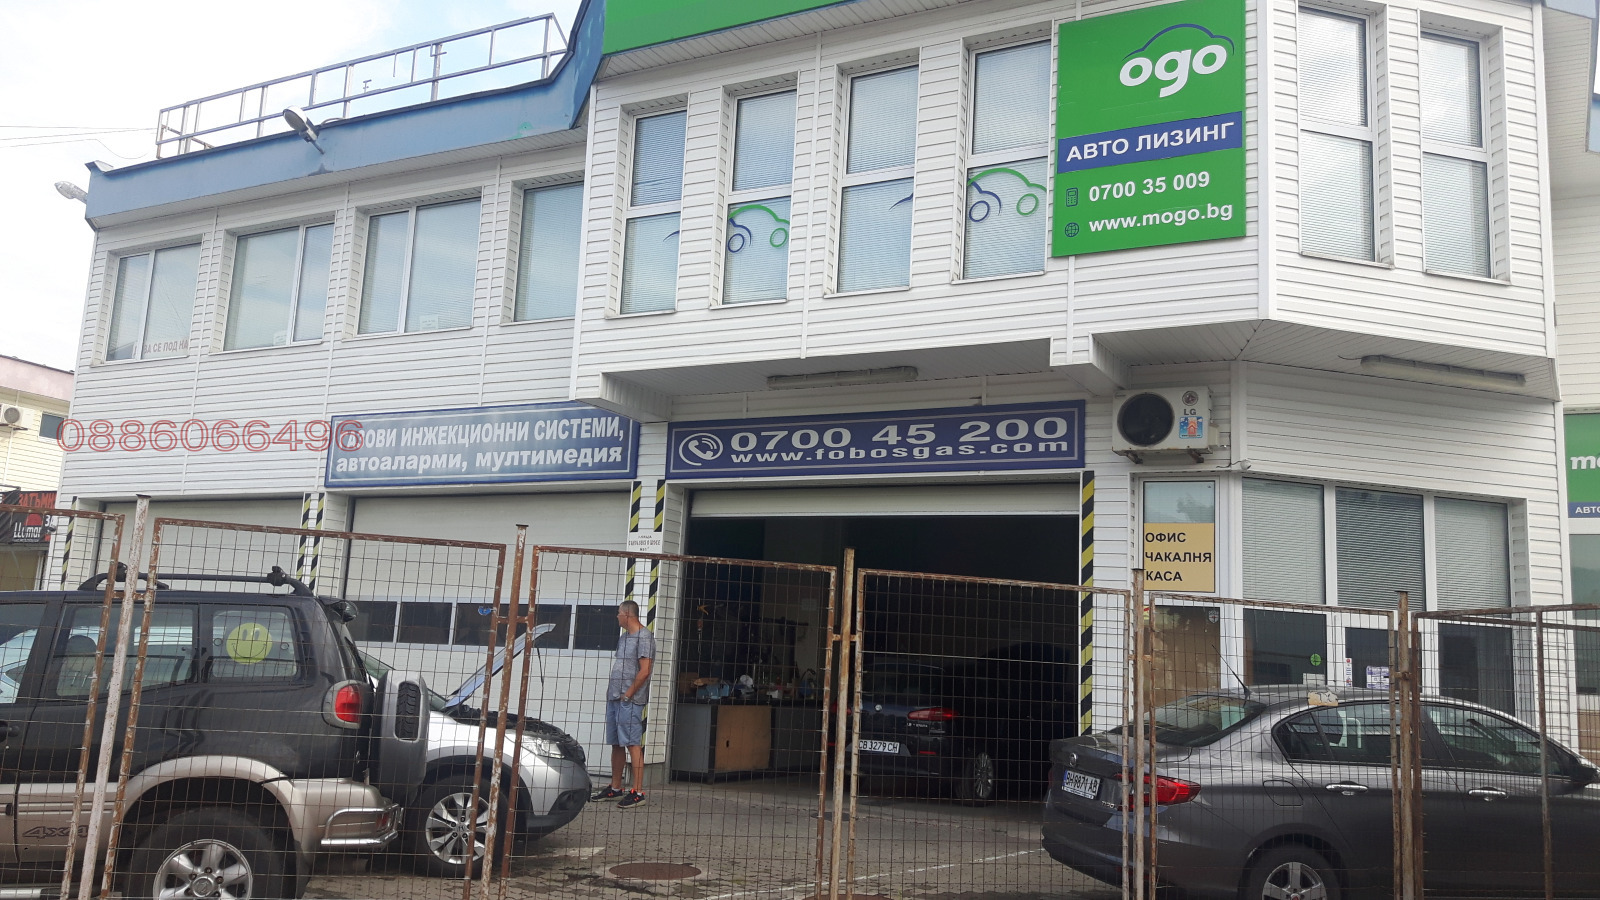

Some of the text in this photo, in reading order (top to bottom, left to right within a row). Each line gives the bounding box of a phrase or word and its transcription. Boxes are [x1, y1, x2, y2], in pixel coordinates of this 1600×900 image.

[1066, 121, 1235, 163] АВТО ЛИЗИНГ
[1088, 171, 1211, 202] 0700 35 009
[1088, 203, 1234, 232] www.mogo.bg
[1183, 408, 1197, 416] LG
[401, 421, 529, 449] ИНЖЕКЦИОННИ
[534, 415, 624, 441] СИСТЕМИ,
[730, 416, 1068, 452] 0700 45 200
[336, 445, 623, 473] автоаларми, мултимедия
[730, 440, 1068, 464] www.fobosgas.com
[1145, 532, 1187, 543] ОФИС
[1145, 552, 1212, 563] ЧАКАЛНЯ
[1145, 571, 1183, 582] КАСА
